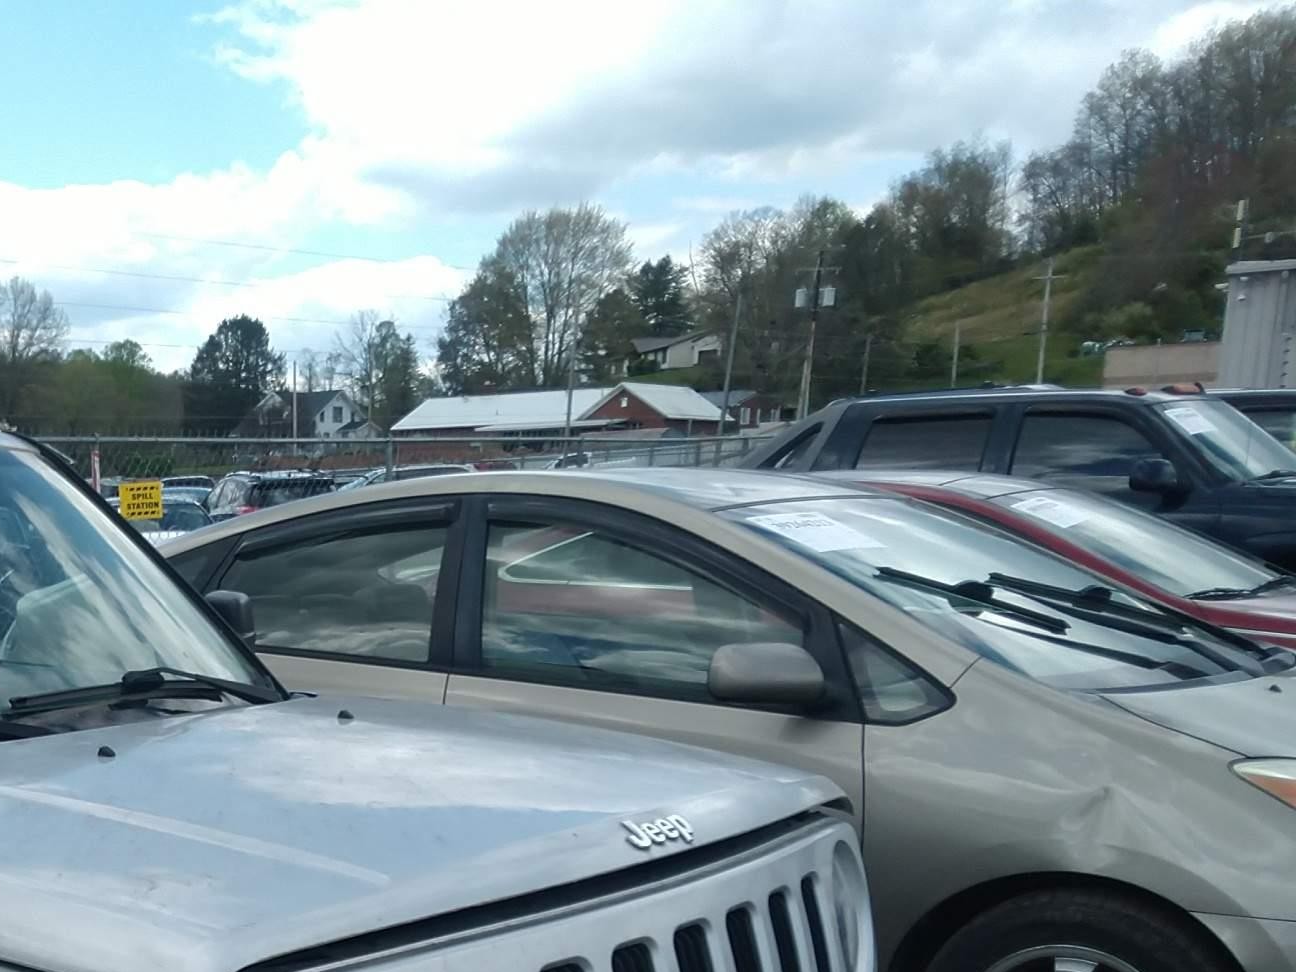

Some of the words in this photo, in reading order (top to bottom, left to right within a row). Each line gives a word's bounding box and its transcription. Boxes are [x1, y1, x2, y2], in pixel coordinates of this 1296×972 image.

[131, 493, 154, 501] SPILL
[126, 501, 160, 510] STATION
[621, 814, 694, 849] Jeep
